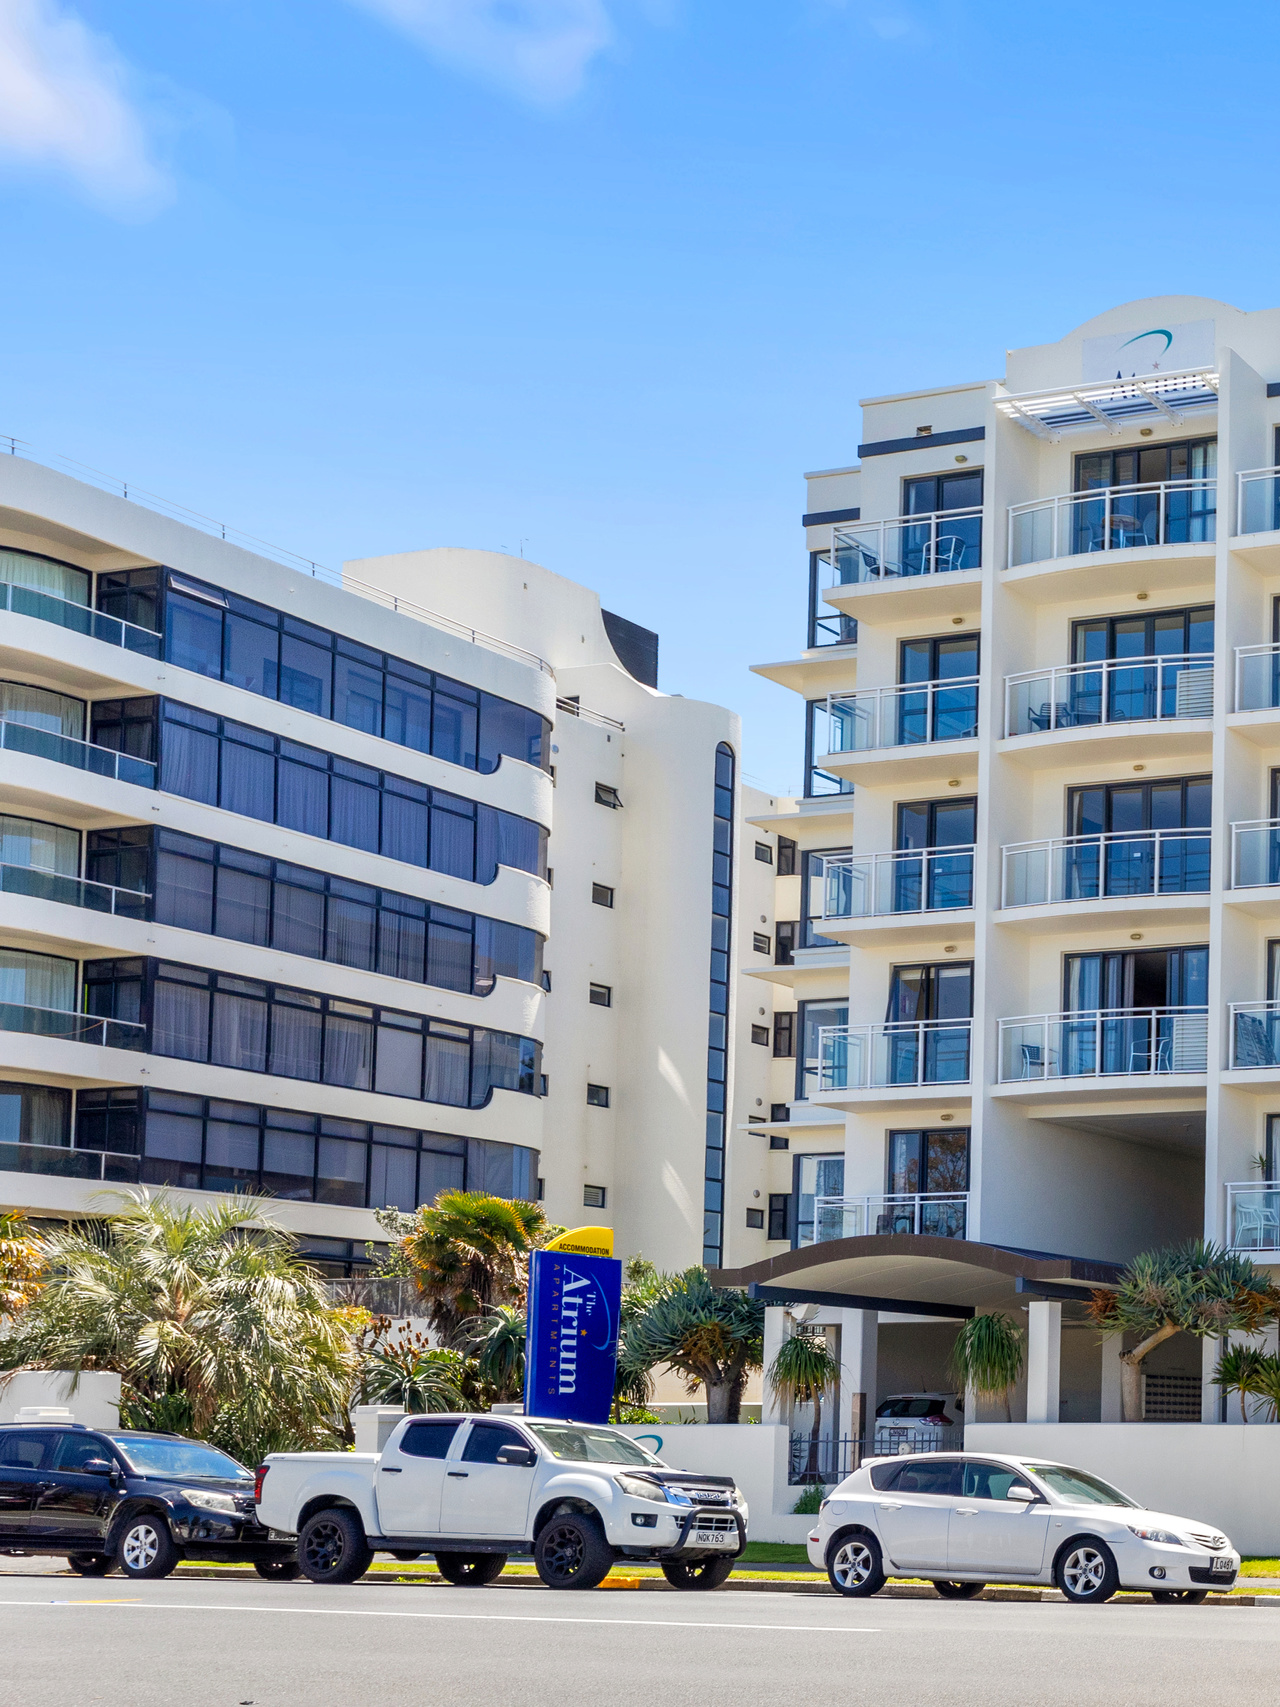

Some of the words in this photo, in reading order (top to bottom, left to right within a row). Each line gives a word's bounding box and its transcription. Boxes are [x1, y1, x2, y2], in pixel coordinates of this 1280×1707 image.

[559, 1243, 609, 1255] ACCOMMODATION
[548, 1264, 560, 1395] APARTMENTS
[558, 1264, 591, 1395] Atrium
[586, 1291, 597, 1316] The
